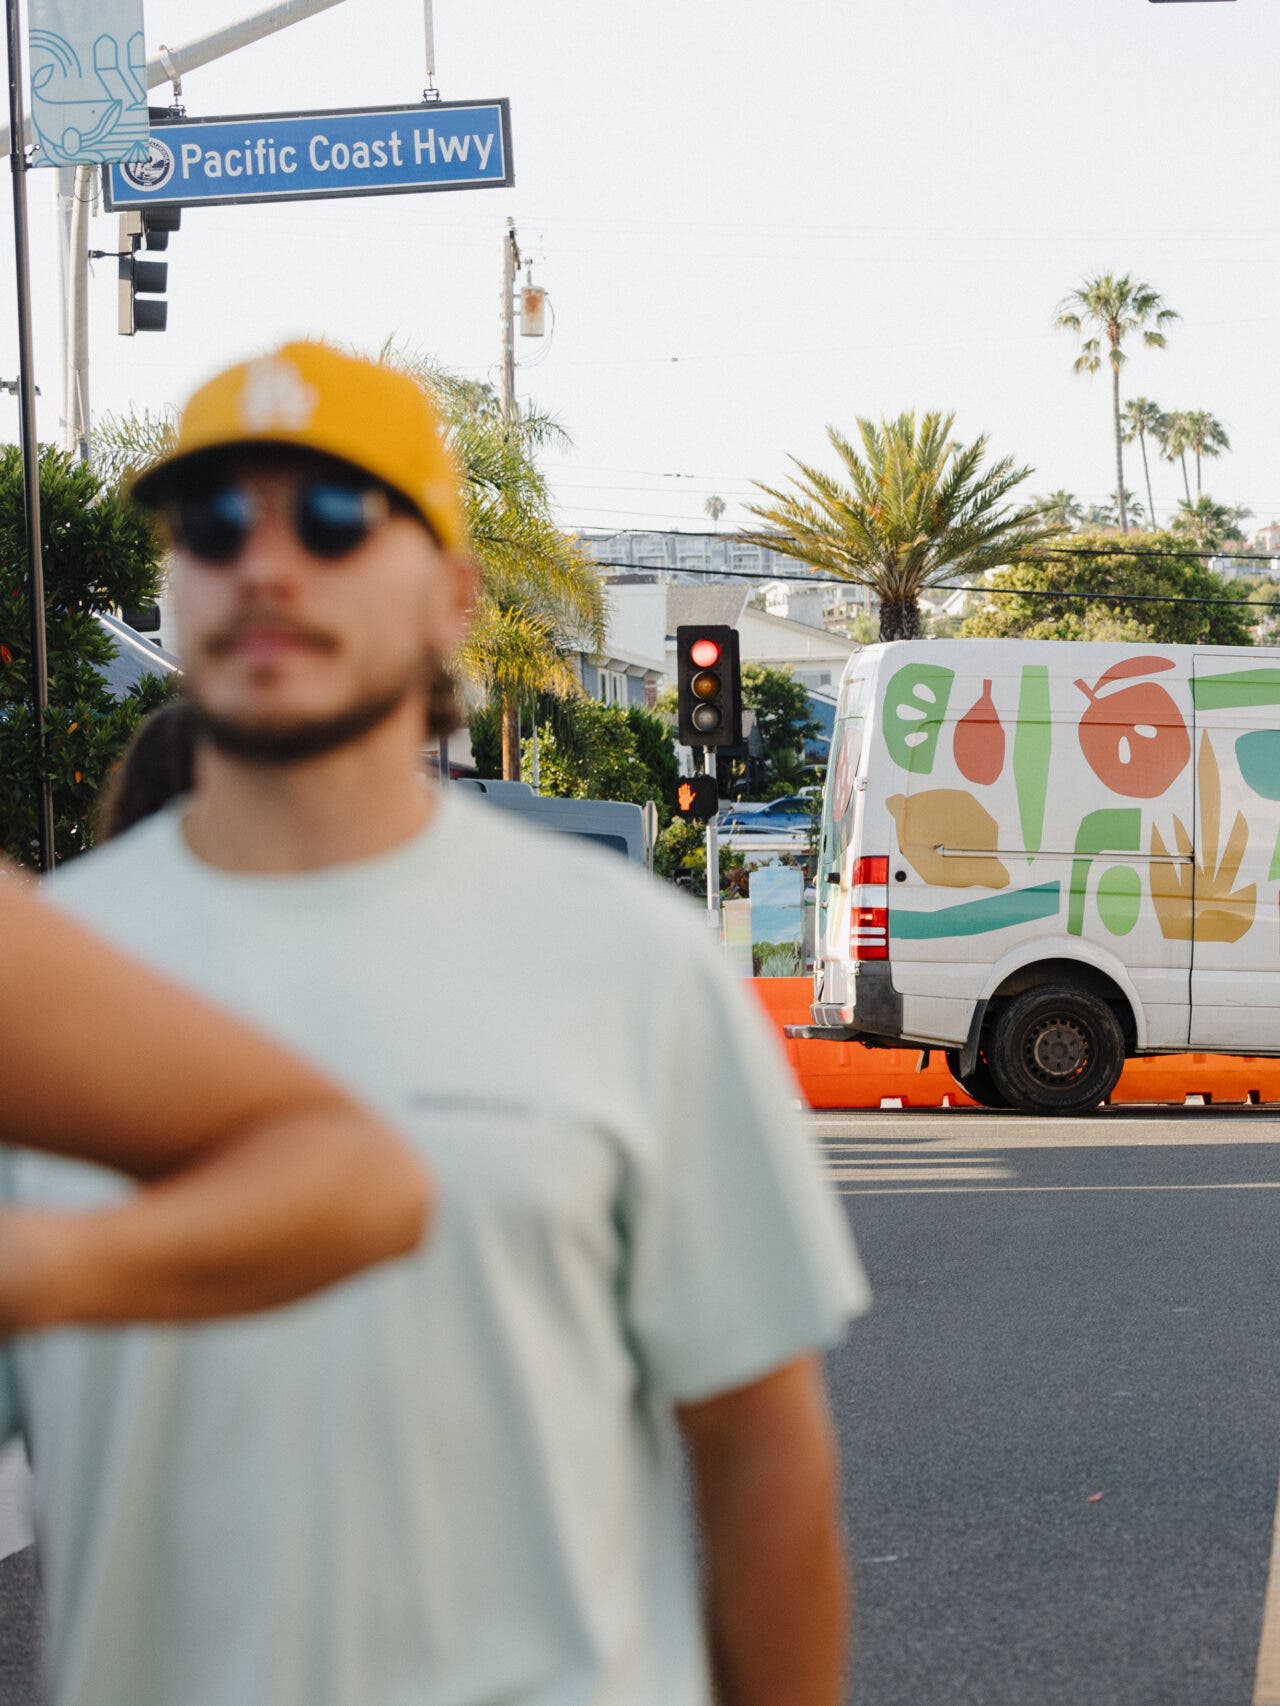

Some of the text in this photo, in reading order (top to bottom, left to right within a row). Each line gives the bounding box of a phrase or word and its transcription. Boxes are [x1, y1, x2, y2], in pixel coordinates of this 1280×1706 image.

[181, 138, 298, 179] Pacific
[309, 130, 403, 171] Coast
[413, 128, 494, 170] Hwy
